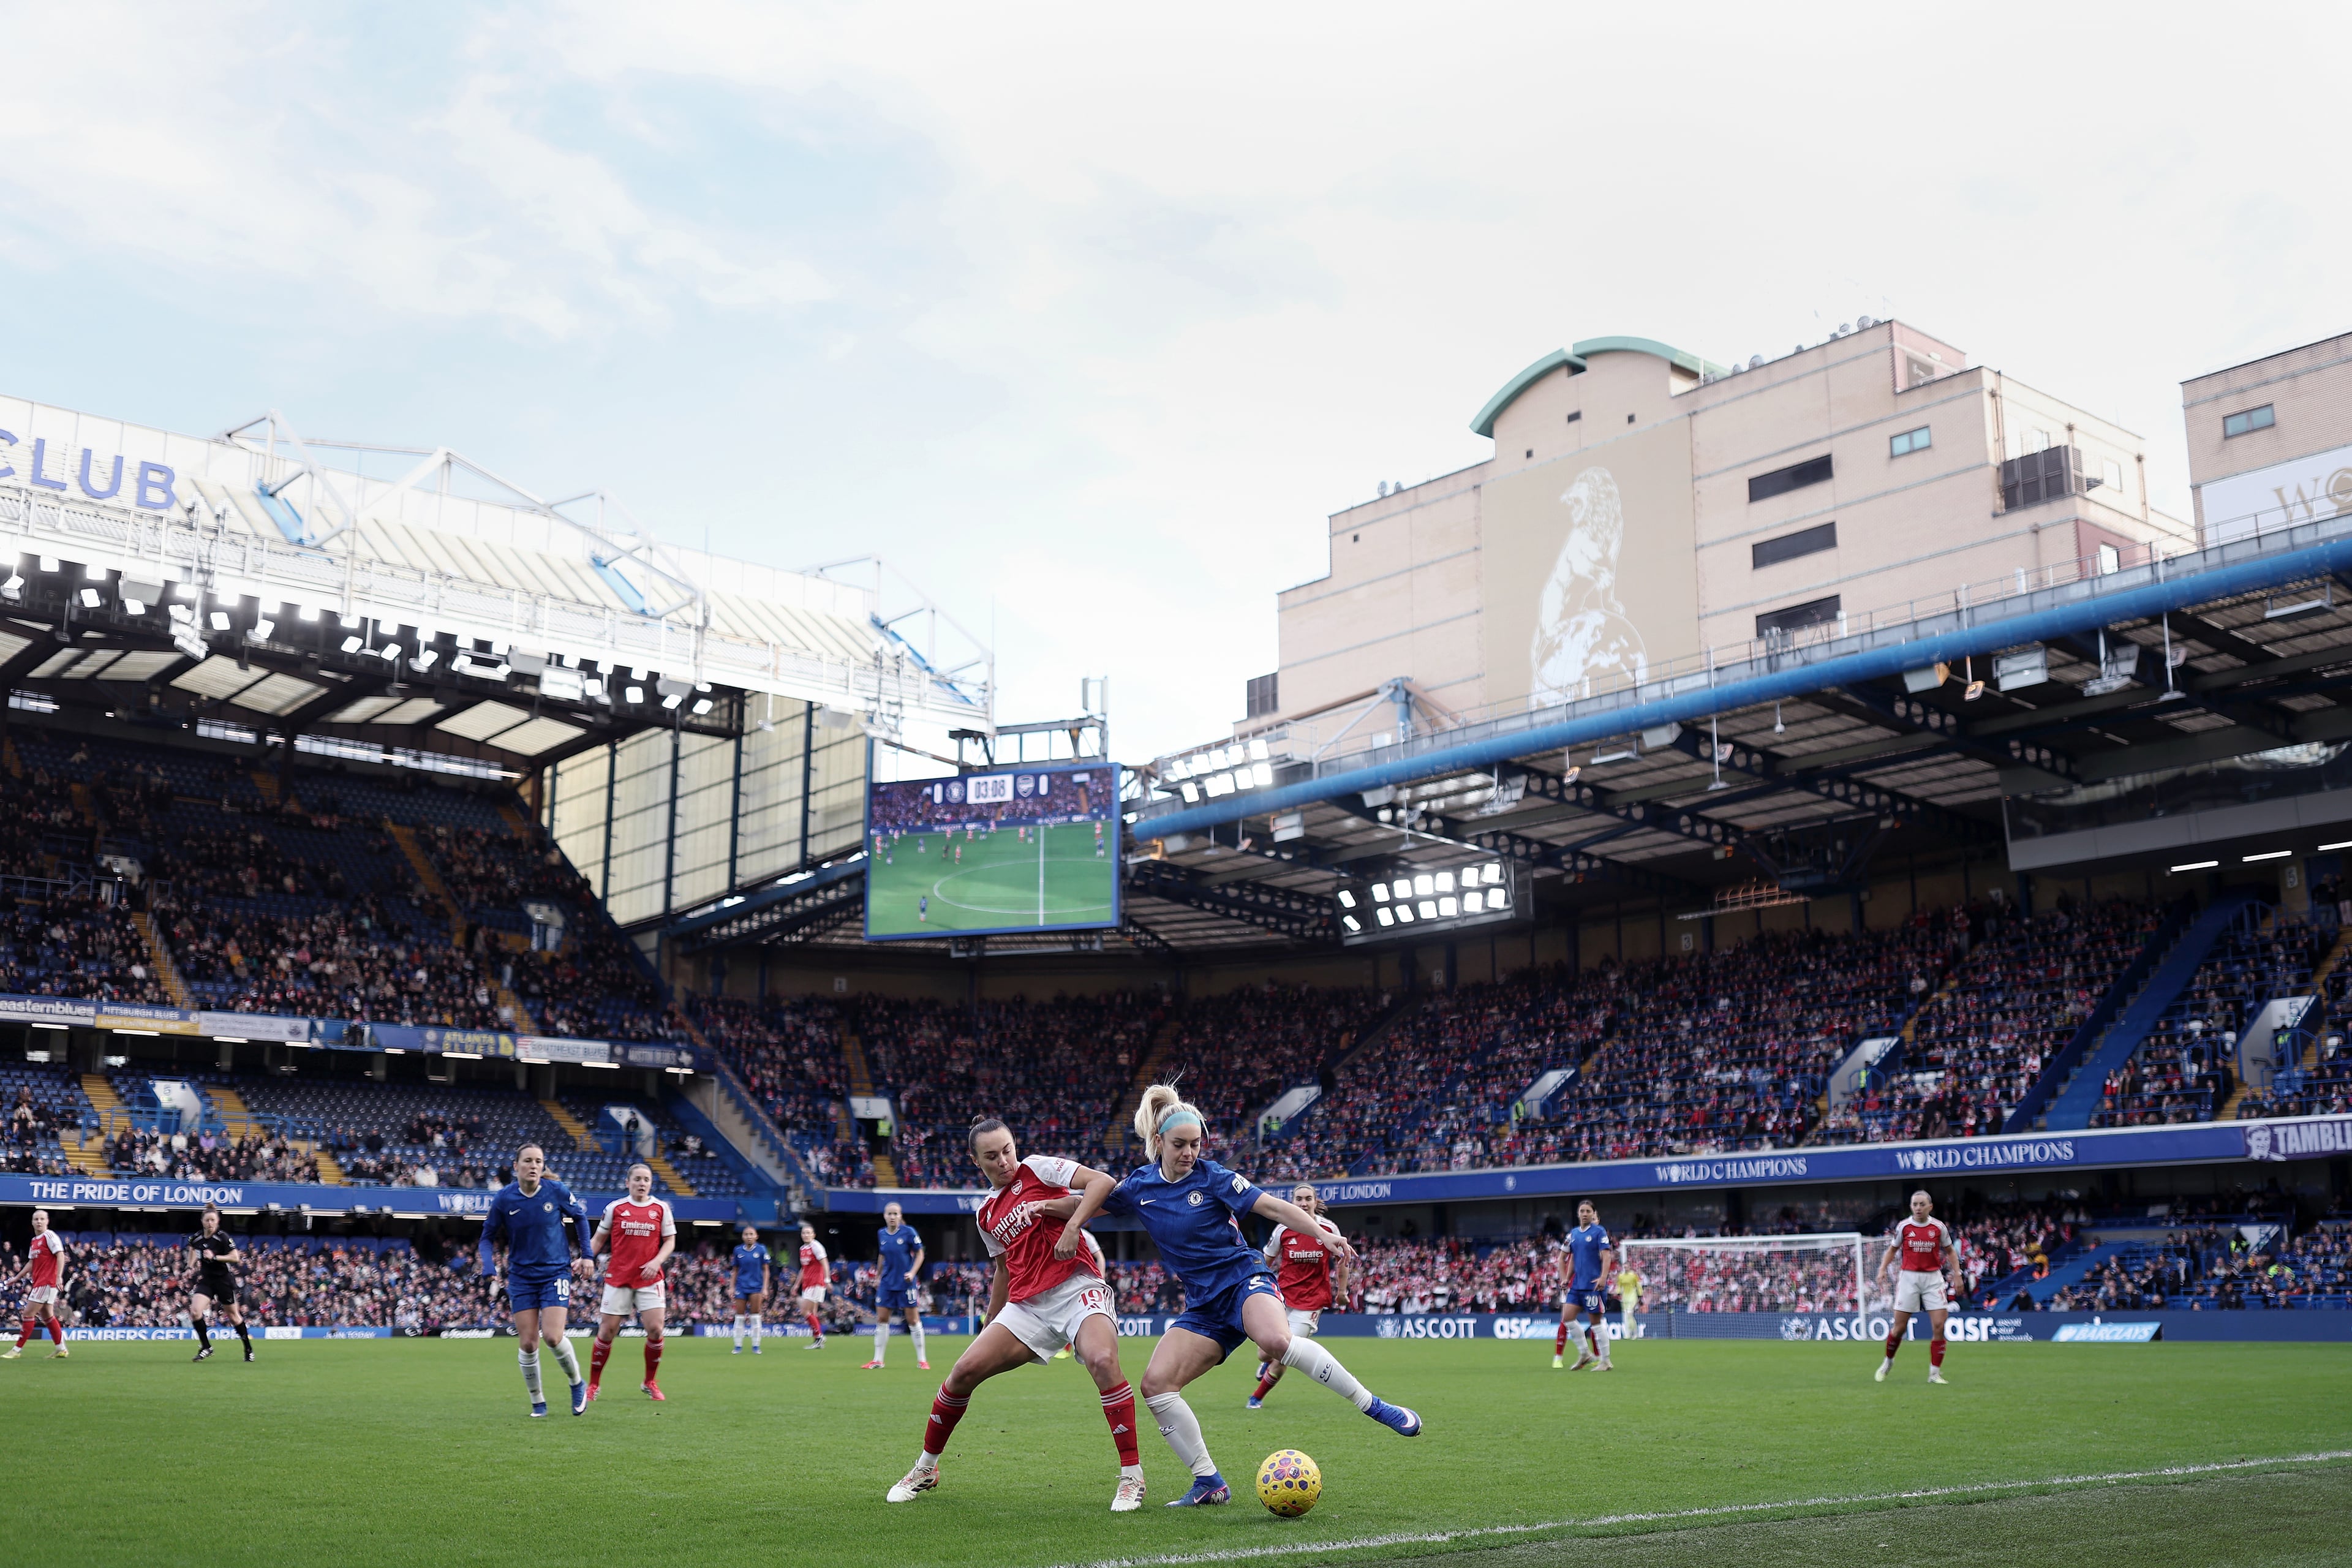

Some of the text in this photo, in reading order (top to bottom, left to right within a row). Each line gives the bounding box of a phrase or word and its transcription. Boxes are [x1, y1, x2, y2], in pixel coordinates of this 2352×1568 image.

[102, 1006, 153, 1017] PITTSBURGH
[154, 1011, 179, 1020] BLUES
[443, 1031, 495, 1044] ATLANTA
[442, 1042, 496, 1055] BLUES
[1896, 1140, 2074, 1170] WORLD CHAMPIONS
[1655, 1157, 1808, 1183] WORLD CHAMPIONS
[29, 1182, 243, 1204] THE PRIDE OF LONDON
[1322, 1186, 1340, 1202] OF
[1341, 1183, 1391, 1200] LONDON
[621, 1220, 656, 1231] Emirates
[991, 1200, 1027, 1241] Emirates
[1289, 1250, 1324, 1259] Emirates
[1079, 1289, 1103, 1306] 19
[1585, 1295, 1599, 1307] 20
[62, 1329, 148, 1340] MEMBERS
[151, 1329, 187, 1340] GET
[1401, 1317, 1477, 1339] ASCOTT
[1815, 1316, 1918, 1341] ASCOT
[1944, 1316, 1994, 1342] asr
[2075, 1325, 2154, 1341] BARCLAYS
[1319, 1363, 1332, 1379] CFC
